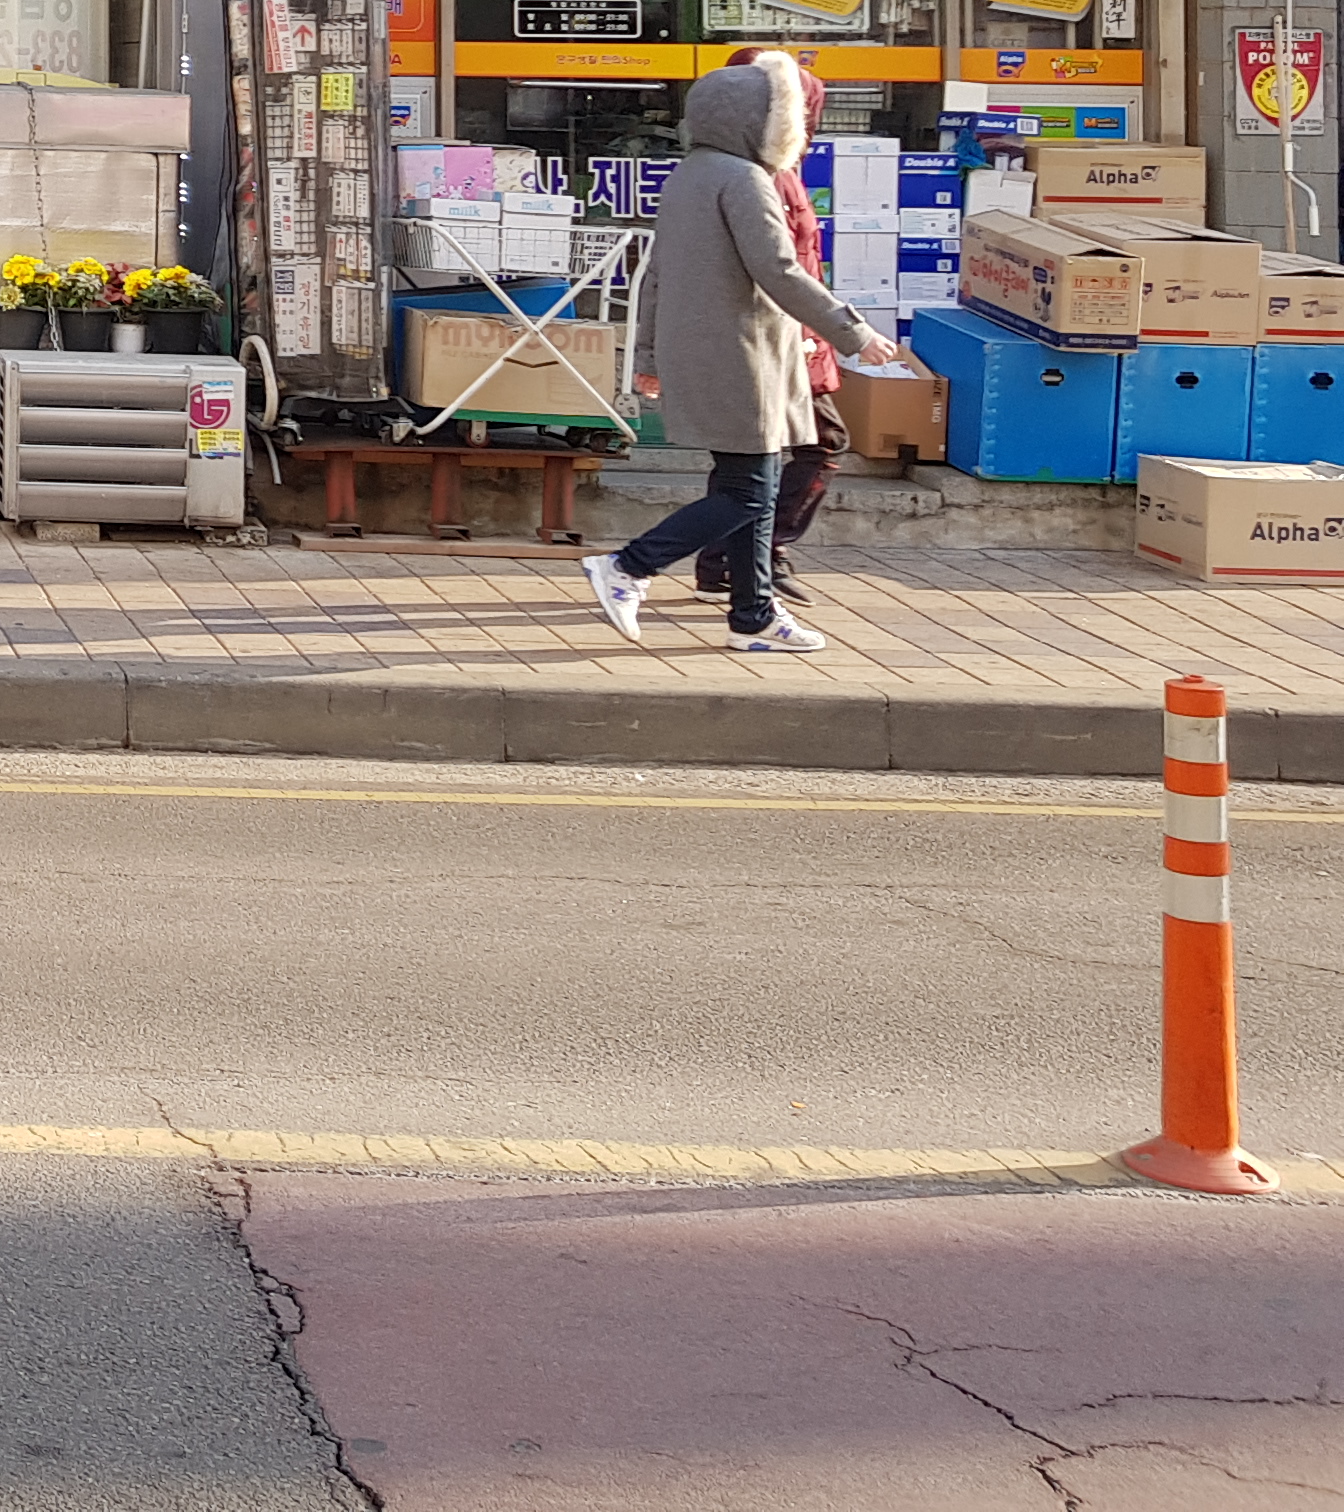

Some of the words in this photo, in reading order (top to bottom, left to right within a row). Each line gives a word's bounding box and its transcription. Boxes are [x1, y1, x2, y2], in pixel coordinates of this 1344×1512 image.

[1248, 52, 1311, 65] POM
[977, 119, 1005, 128] Double
[904, 157, 944, 168] Double
[945, 157, 957, 168] A
[1085, 169, 1139, 186] Alpha
[901, 241, 928, 250] Double
[298, 280, 312, 349] 정기휴일
[1249, 520, 1321, 544] Alpha
